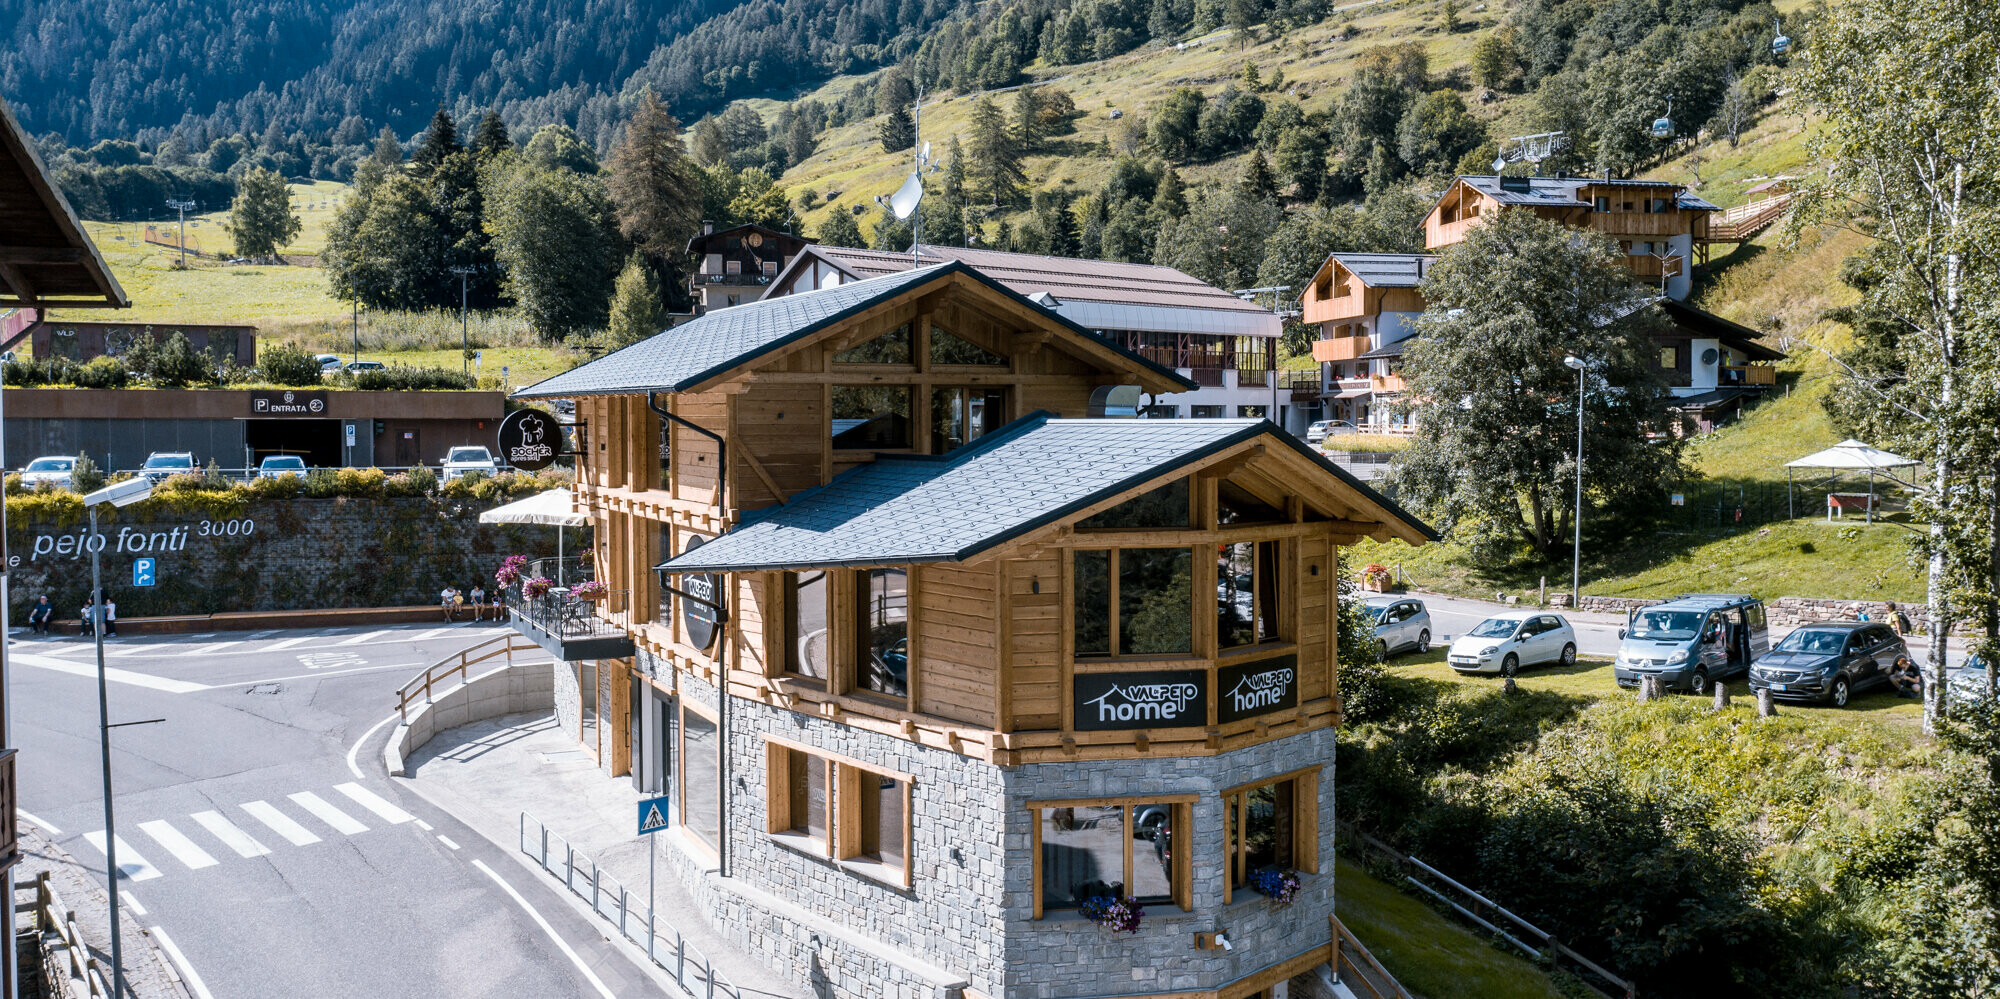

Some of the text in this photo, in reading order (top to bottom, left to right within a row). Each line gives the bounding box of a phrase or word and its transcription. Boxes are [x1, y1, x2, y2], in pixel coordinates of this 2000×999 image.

[271, 404, 307, 412] ENTRATA
[31, 519, 255, 561] pejo fonti 3000
[138, 560, 151, 574] P
[1100, 697, 1177, 722] home
[1234, 686, 1281, 713] home
